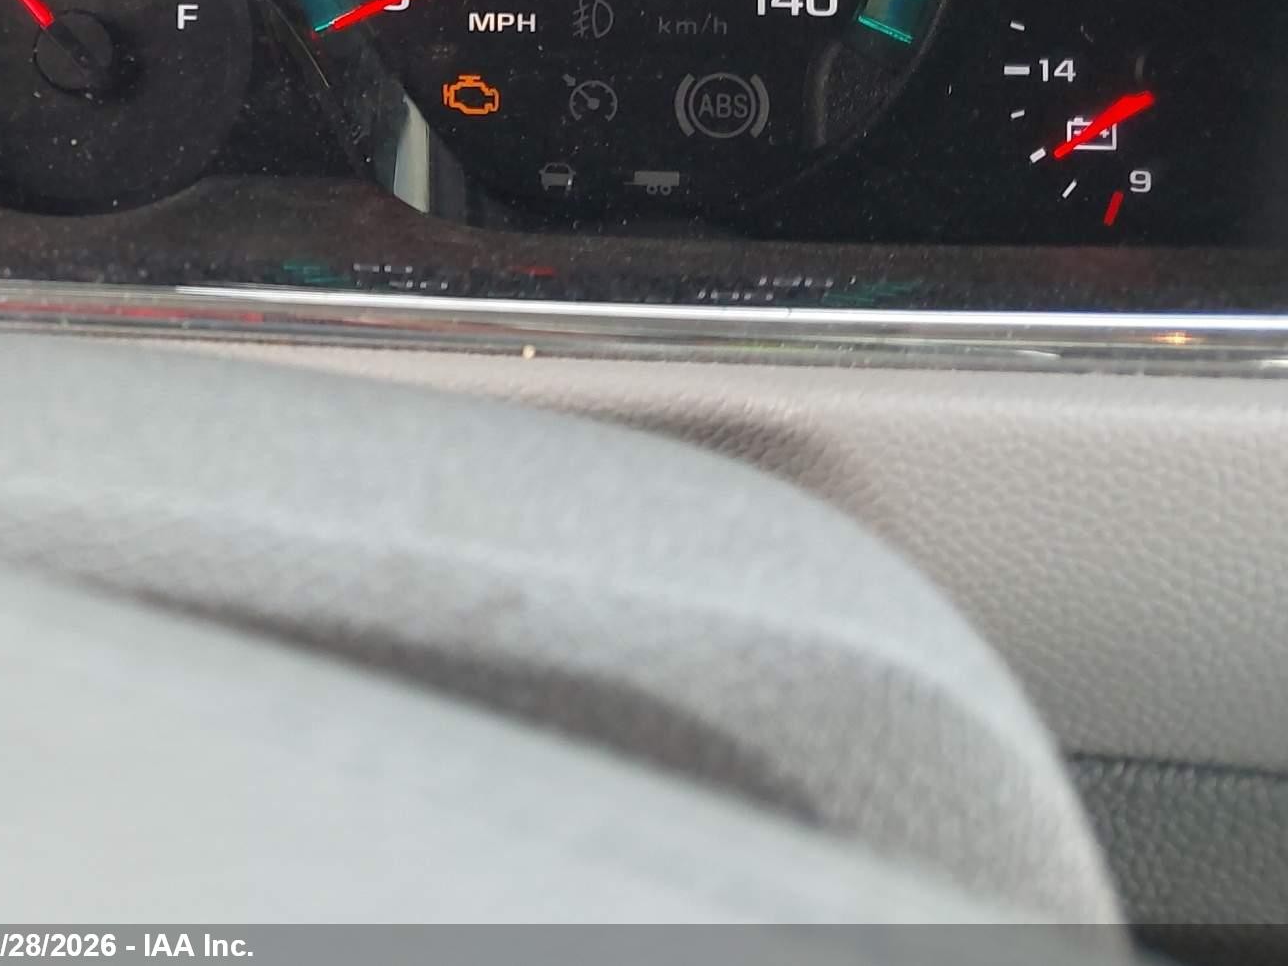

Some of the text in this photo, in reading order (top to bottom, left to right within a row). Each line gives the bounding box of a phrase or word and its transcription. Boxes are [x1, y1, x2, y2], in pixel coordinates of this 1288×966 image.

[176, 3, 199, 30] F
[468, 11, 536, 33] MPH
[658, 17, 727, 35] km/h
[1038, 58, 1077, 82] 14
[698, 93, 749, 120] ABS
[1129, 169, 1153, 193] 9
